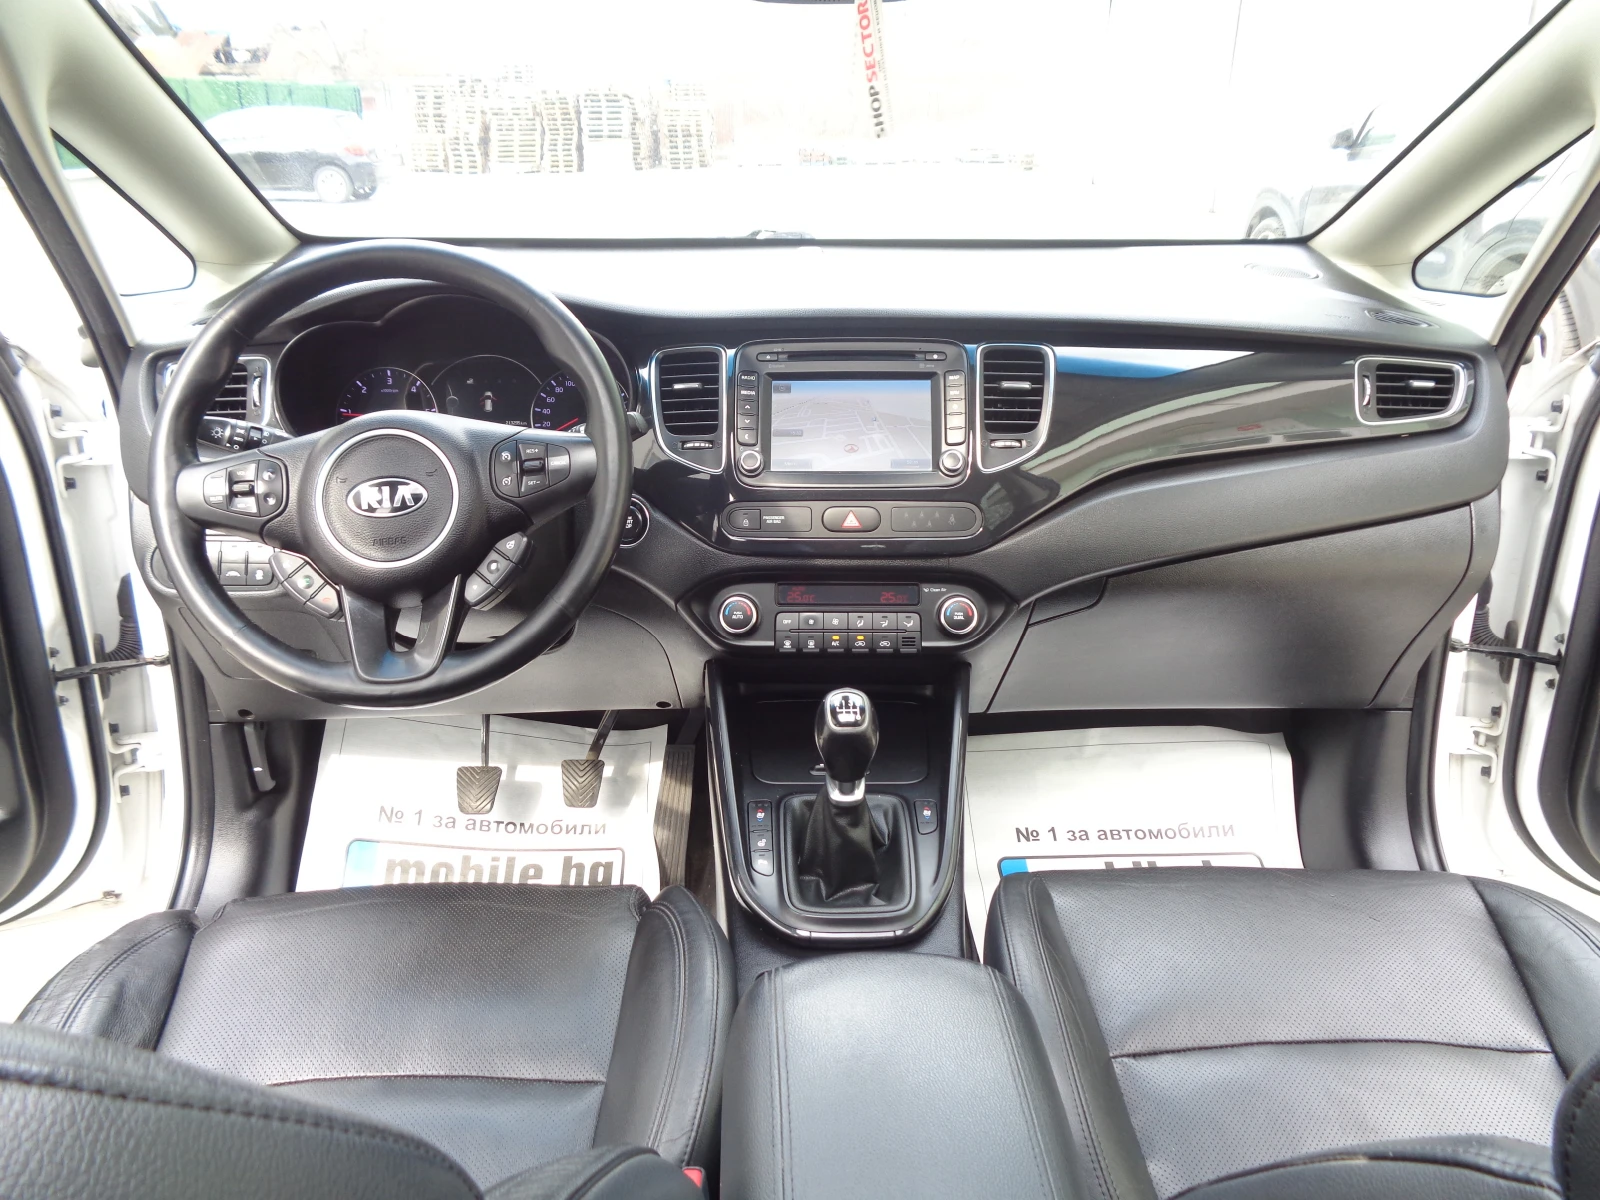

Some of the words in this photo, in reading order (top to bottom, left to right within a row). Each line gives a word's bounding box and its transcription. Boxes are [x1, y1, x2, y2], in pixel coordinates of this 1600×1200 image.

[361, 386, 367, 394] 2
[358, 484, 415, 510] KIA
[414, 809, 423, 826] 1
[433, 815, 456, 829] за
[465, 818, 607, 836] автомобили
[1048, 826, 1058, 842] 1
[1066, 829, 1090, 842] за
[1097, 822, 1236, 842] автомобили
